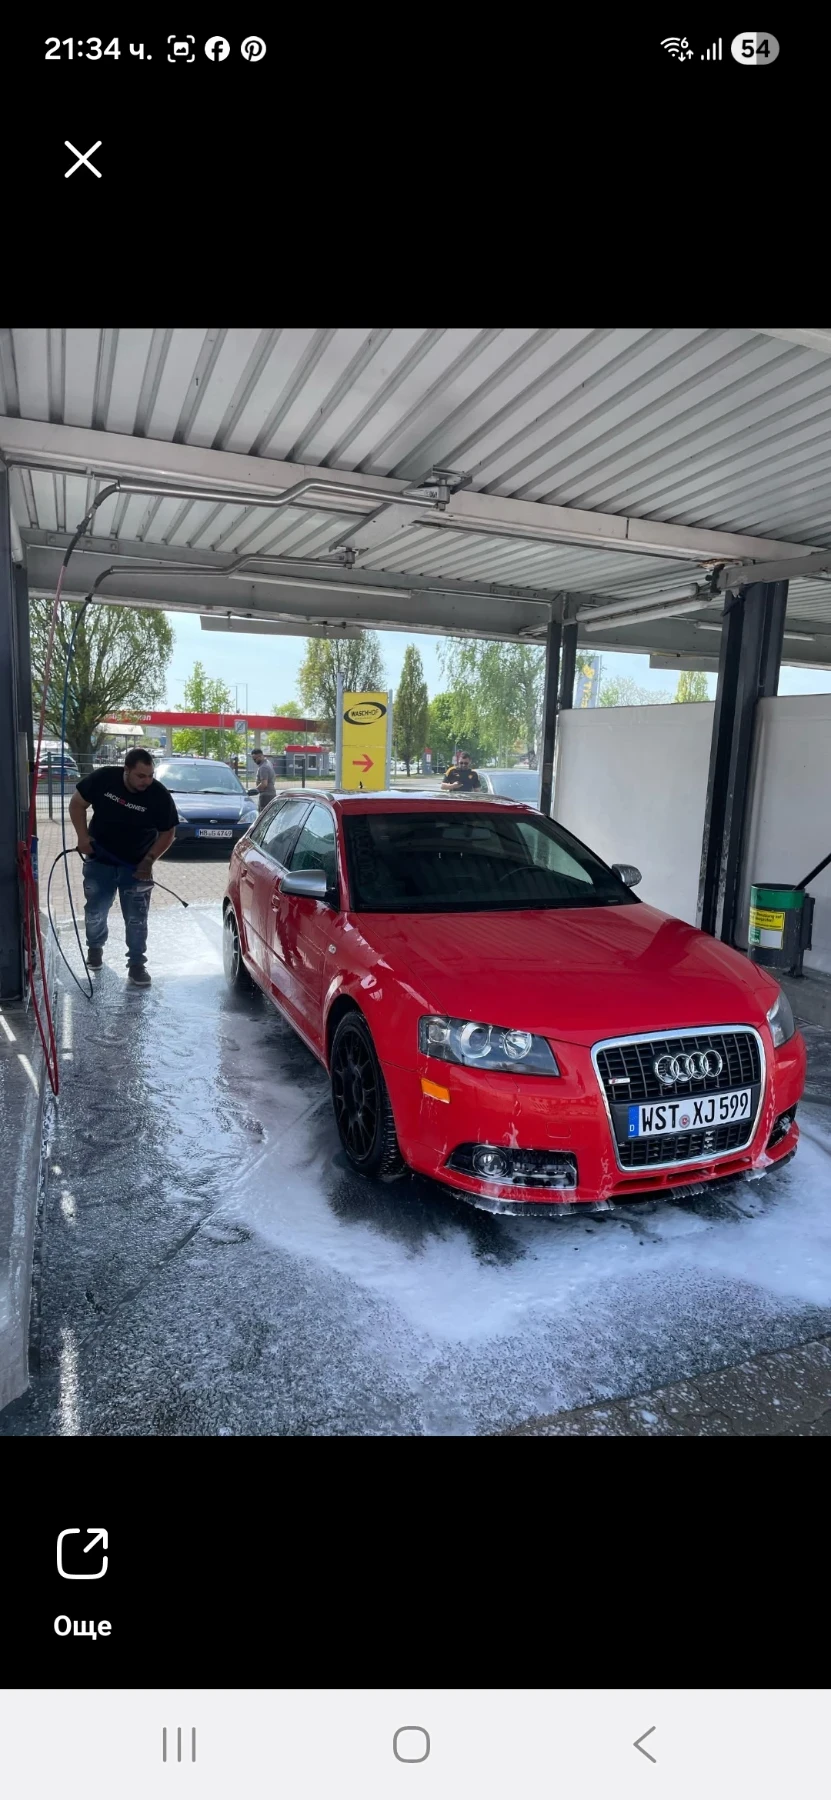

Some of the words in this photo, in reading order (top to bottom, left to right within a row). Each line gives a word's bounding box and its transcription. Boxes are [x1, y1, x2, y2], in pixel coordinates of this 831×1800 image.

[104, 792, 120, 802] JACK
[125, 802, 147, 812] JONES
[629, 1124, 635, 1132] D
[641, 1104, 680, 1133] WST
[693, 1099, 715, 1126] XJ
[719, 1092, 749, 1121] 599
